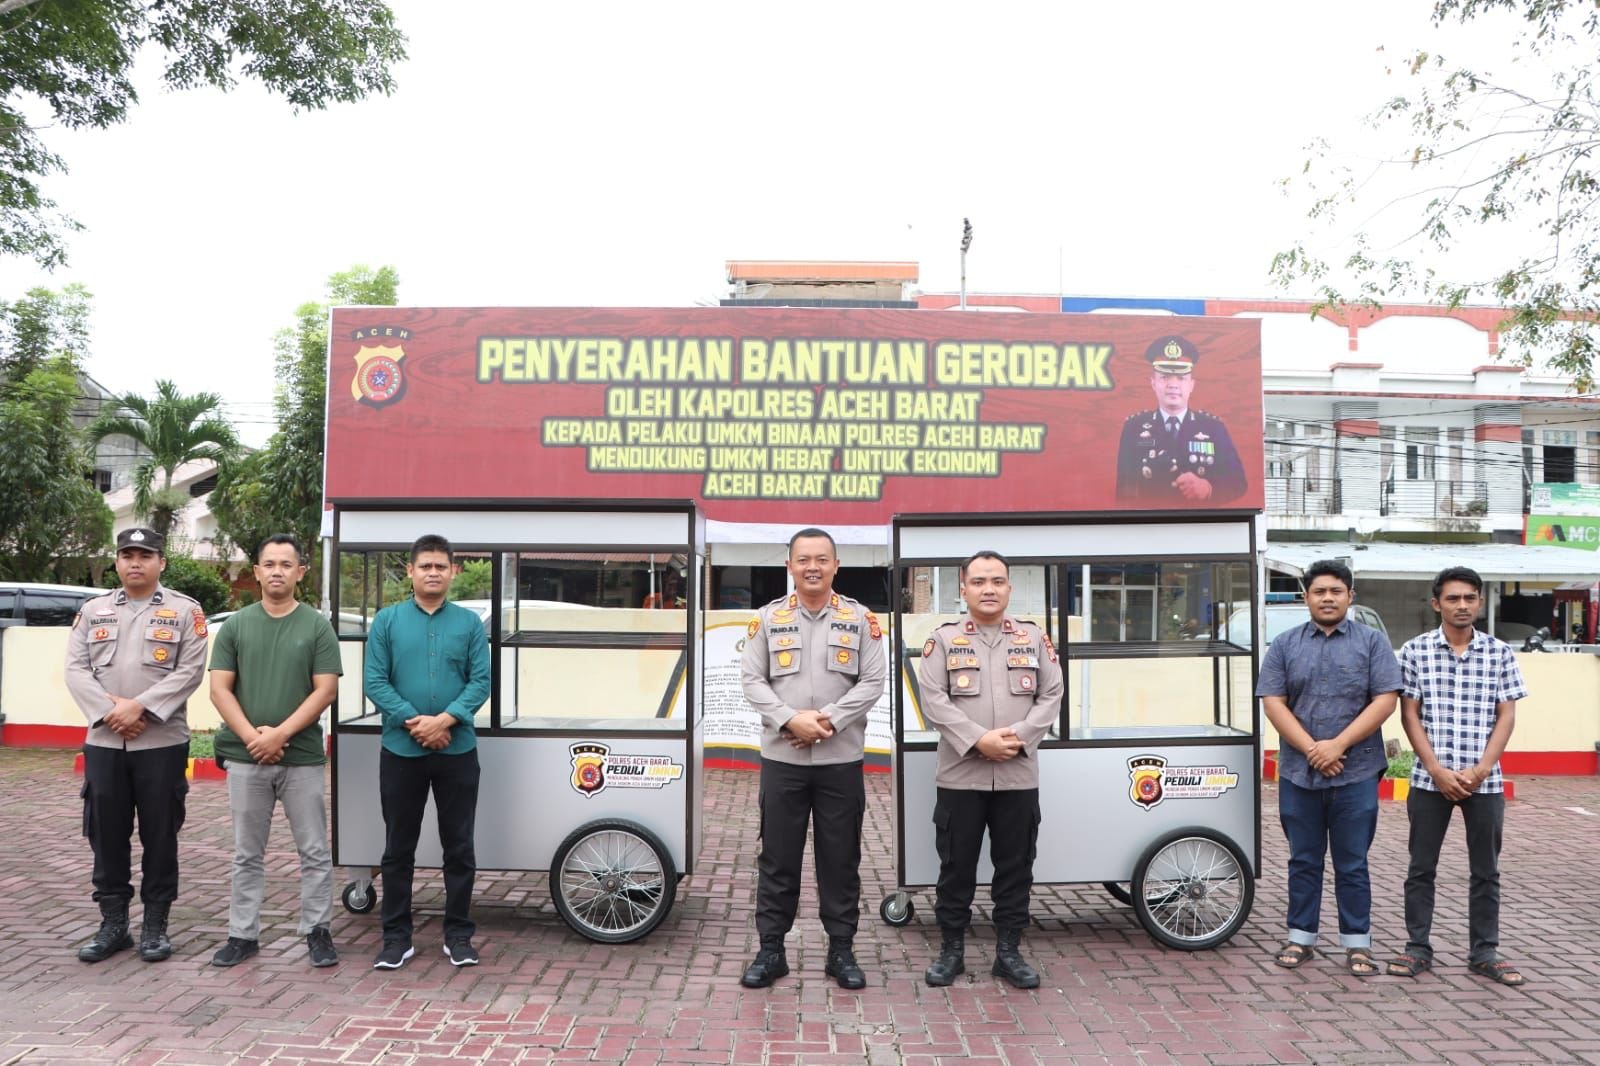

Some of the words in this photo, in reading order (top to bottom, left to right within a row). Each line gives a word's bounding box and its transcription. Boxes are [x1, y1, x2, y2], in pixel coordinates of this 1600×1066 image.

[356, 327, 409, 339] ACEH
[479, 339, 732, 381] PENYERAHAN
[742, 340, 925, 384] BANTUAN
[935, 343, 1110, 387] GEROBAK
[608, 388, 673, 417] OLEH
[679, 388, 813, 418] KAPOLRES
[820, 390, 889, 420] ACEH
[895, 391, 981, 421] BARAT
[545, 420, 623, 444] KEPADA
[626, 421, 702, 445] PELAKU
[706, 422, 763, 445] UMKM
[767, 422, 841, 446] BINAAN
[845, 423, 919, 447] POLRES
[923, 424, 976, 448] ACEH
[979, 425, 1044, 449] BARAT
[590, 446, 707, 470] MENDUKUNG
[710, 447, 768, 471] UMKM
[772, 448, 833, 471] HEBAT
[843, 449, 909, 472] UNTUK
[913, 450, 997, 474] EKONOMI
[705, 473, 757, 496] ACEH
[761, 473, 826, 497] BARAT
[831, 474, 881, 497] KUAT
[1568, 526, 1600, 542] MC
[150, 618, 179, 627] POLRI
[830, 622, 859, 633] POLRI
[632, 757, 648, 765] ACEH
[649, 758, 670, 766] BARAT
[606, 765, 645, 776] PEDULI
[1189, 768, 1205, 776] ACEH
[1206, 767, 1226, 776] BARAT
[1164, 776, 1202, 786] PEDULI
